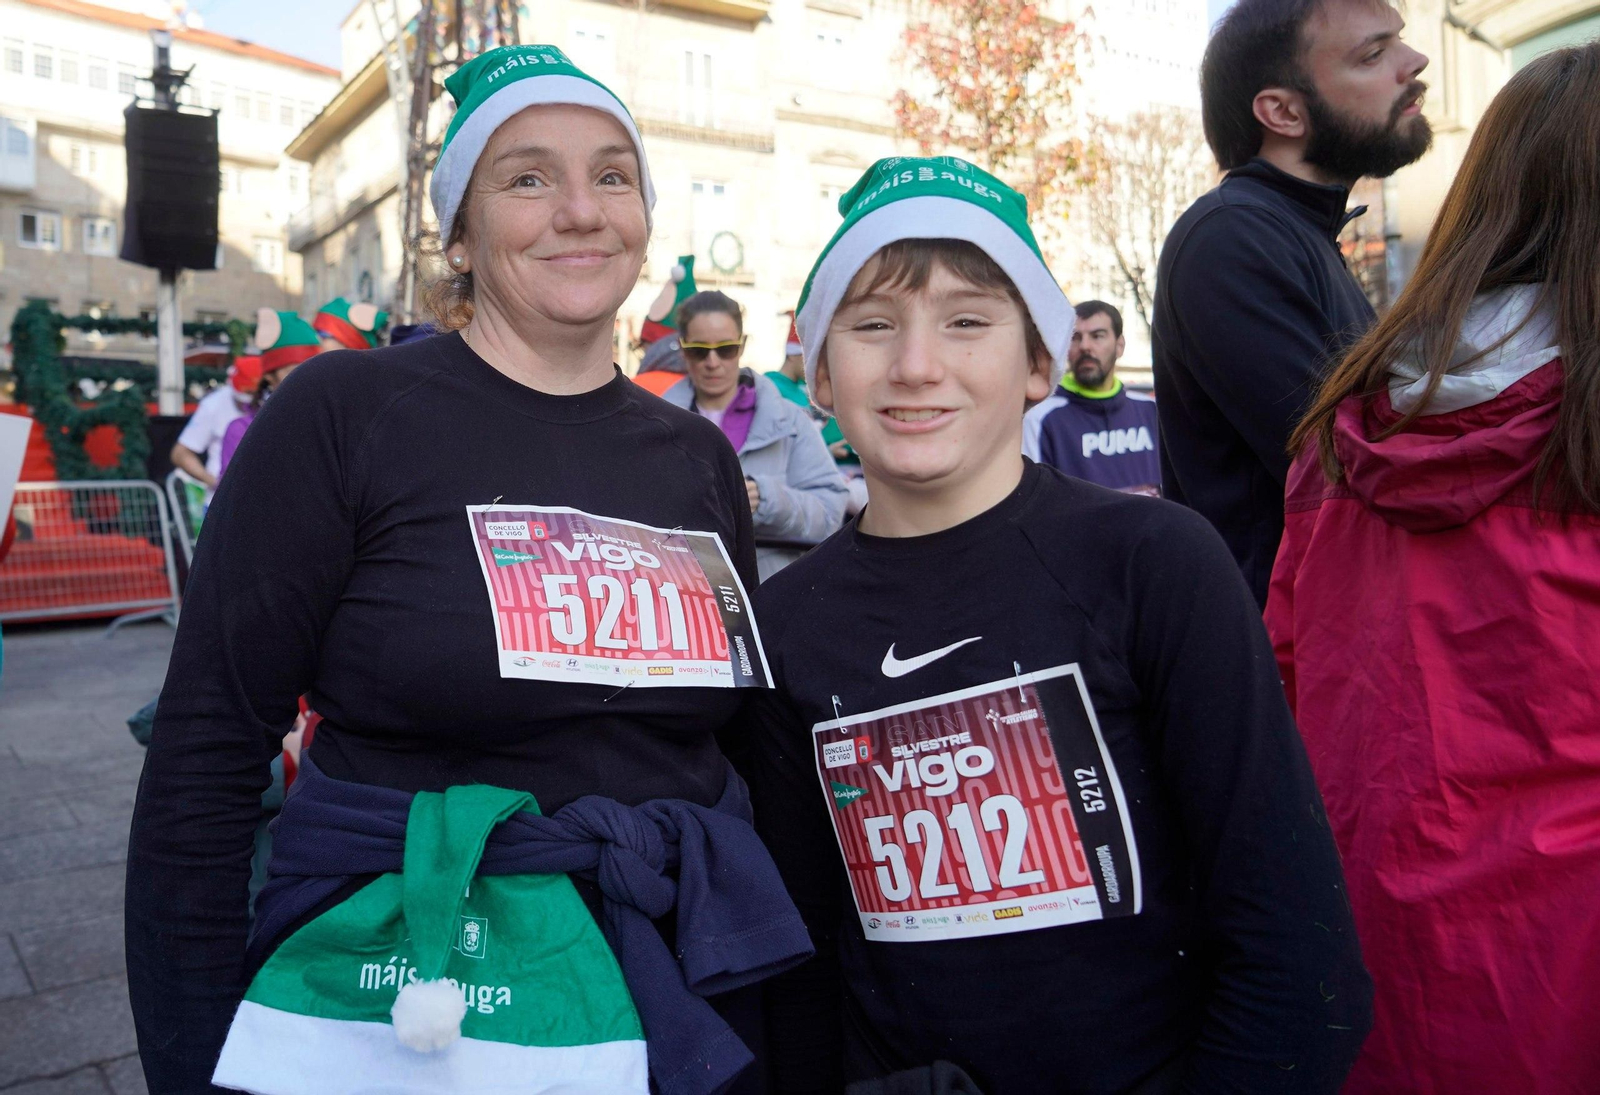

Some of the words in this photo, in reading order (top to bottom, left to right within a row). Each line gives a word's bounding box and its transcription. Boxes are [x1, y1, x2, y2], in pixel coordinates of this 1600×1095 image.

[487, 54, 540, 83] máis
[857, 170, 913, 210] máis
[941, 171, 1003, 203] auga
[1082, 426, 1154, 458] PUMA
[572, 533, 643, 549] SILVESTRE
[550, 541, 660, 571] vigo
[541, 574, 690, 651] 5211
[719, 585, 740, 613] 5211
[648, 666, 673, 675] GADIS
[825, 744, 853, 756] CONCELLO
[838, 753, 850, 761] VIGO
[891, 732, 971, 758] SILVESTRE
[872, 745, 995, 797] vigo
[1073, 766, 1107, 813] 5212
[863, 794, 1046, 902] 5212
[994, 907, 1022, 918] GADIS
[1028, 901, 1058, 912] avanza
